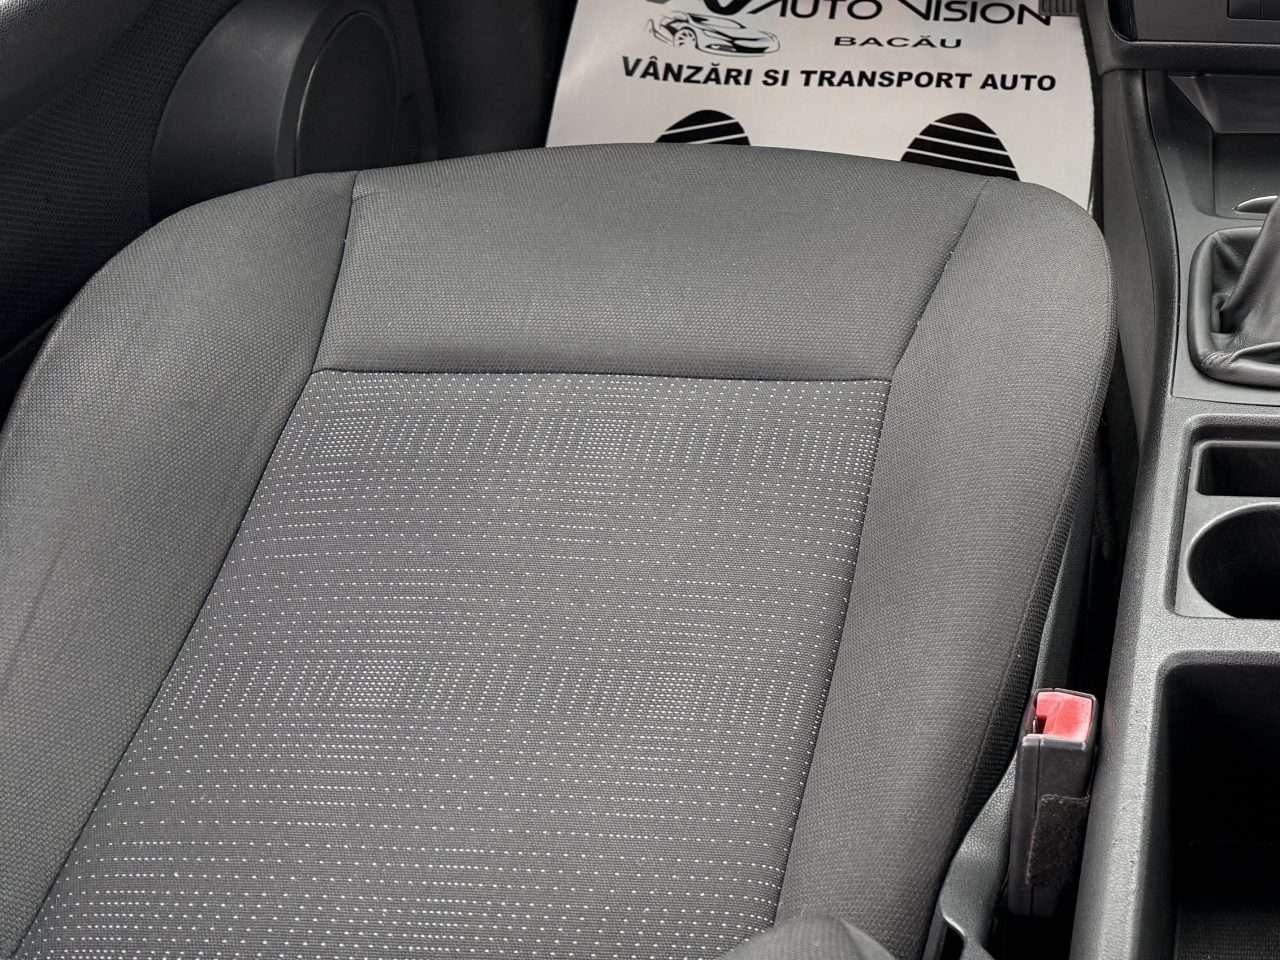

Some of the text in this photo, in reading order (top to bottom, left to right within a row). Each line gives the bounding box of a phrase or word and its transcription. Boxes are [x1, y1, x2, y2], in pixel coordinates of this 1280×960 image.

[834, 35, 962, 49] BACĂU
[622, 56, 1056, 92] VÂNZĂRI SI TRANSPORT AUTO
